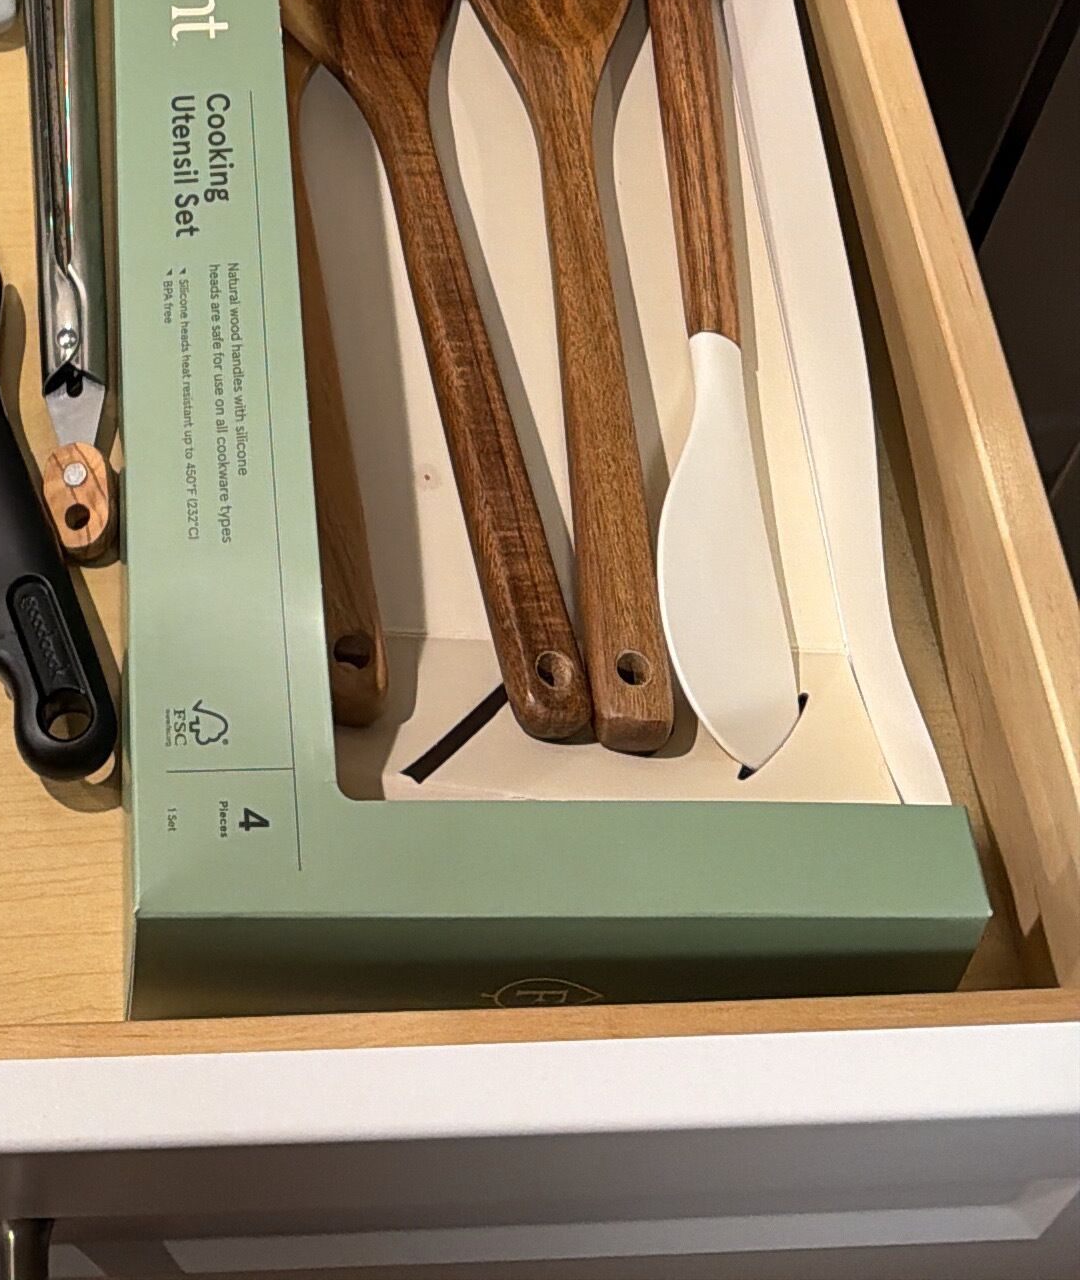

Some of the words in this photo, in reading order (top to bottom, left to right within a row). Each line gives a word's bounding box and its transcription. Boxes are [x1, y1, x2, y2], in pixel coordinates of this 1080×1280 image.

[171, 95, 199, 184] Utensil
[204, 93, 234, 203] Cooking
[175, 193, 200, 238] Set
[163, 280, 173, 301] BPA
[179, 278, 190, 319] Silicone
[209, 264, 221, 300] heads
[227, 262, 240, 305] Natural
[164, 303, 174, 324] free
[211, 302, 220, 322] are
[230, 307, 243, 342] wood
[180, 321, 191, 353] heads
[212, 325, 224, 350] safe
[182, 354, 192, 379] heat
[213, 352, 225, 370] for
[232, 344, 245, 393] handles
[214, 374, 224, 396] use
[183, 381, 194, 428] resistant
[215, 398, 224, 416] on
[234, 395, 247, 422] with
[182, 430, 193, 445] up
[216, 419, 228, 434] all
[185, 447, 194, 460] to
[236, 425, 248, 476] silicone
[186, 462, 197, 496] 450°F
[217, 436, 230, 502] cookware
[217, 505, 232, 544] types
[173, 708, 188, 746] FSC
[168, 814, 177, 832] Set
[219, 800, 228, 838] Pieces
[239, 807, 270, 831] 4
